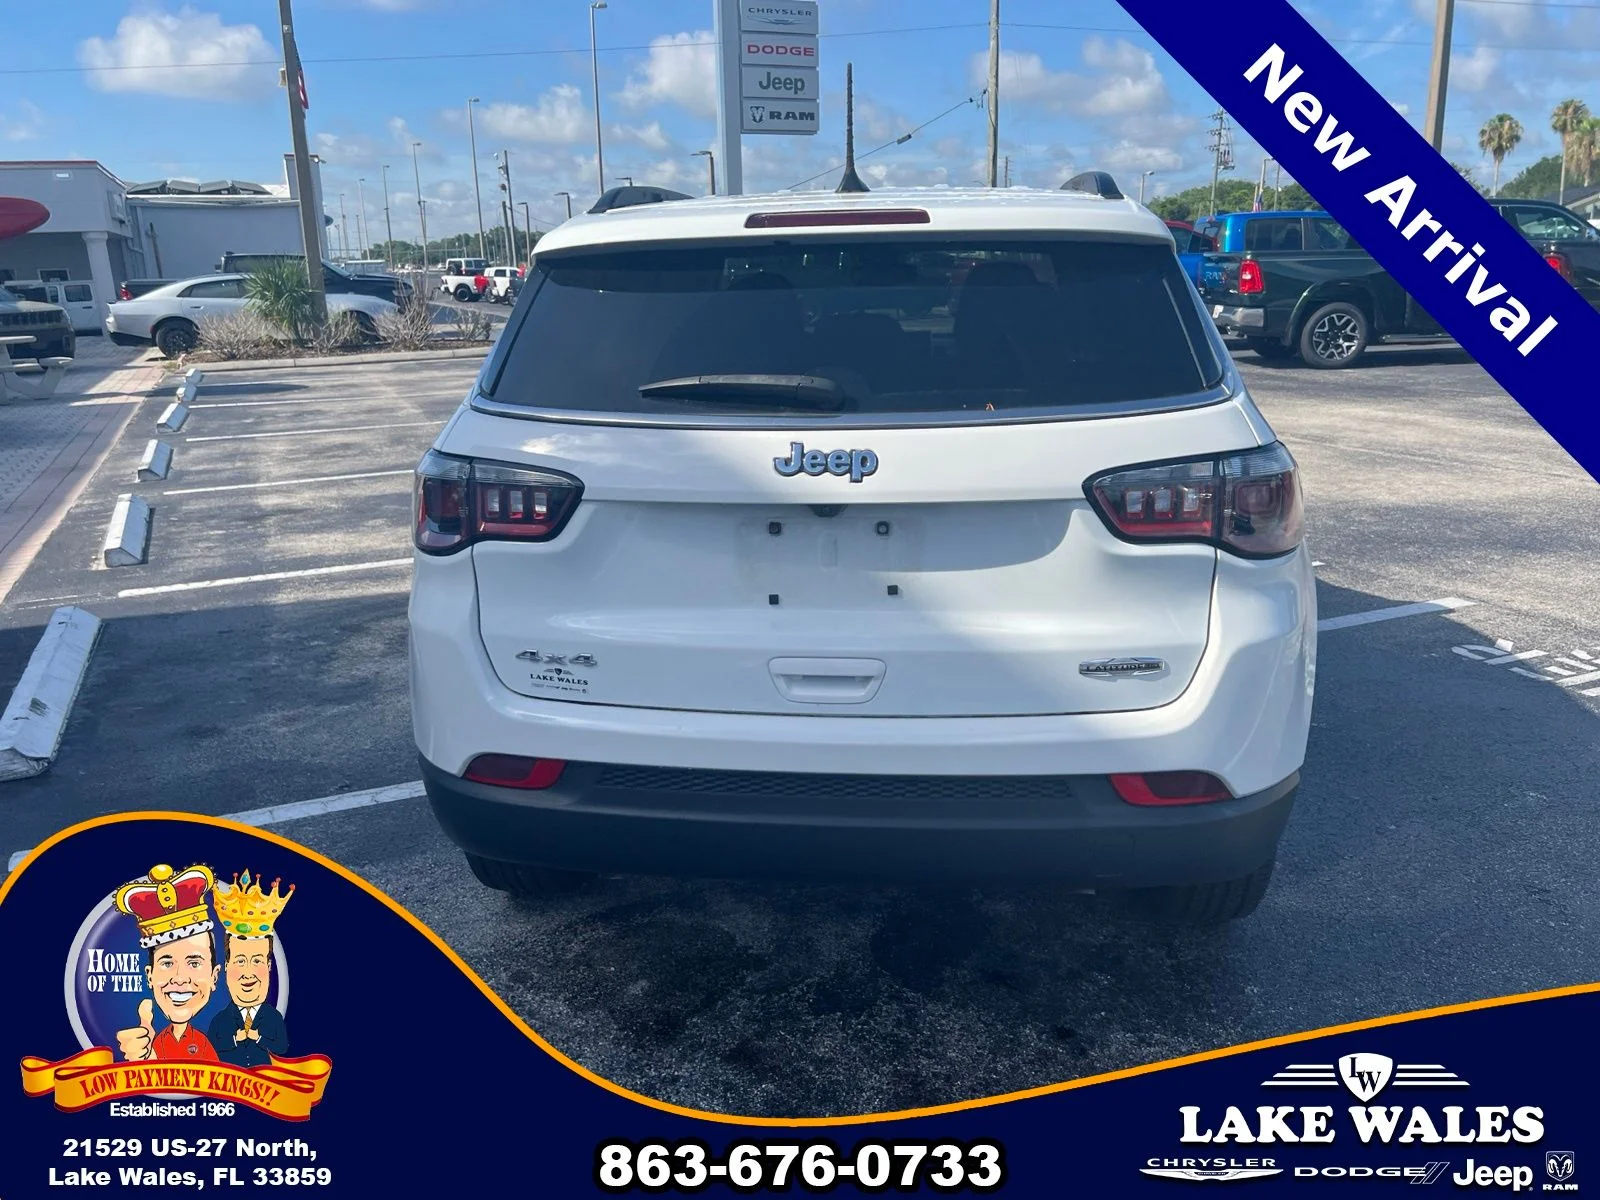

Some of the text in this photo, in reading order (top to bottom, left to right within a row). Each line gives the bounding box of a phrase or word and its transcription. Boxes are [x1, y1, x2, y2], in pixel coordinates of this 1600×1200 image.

[748, 7, 812, 16] CHRYSLER
[747, 44, 815, 56] DODGE
[759, 71, 805, 94] Jeep
[769, 111, 815, 120] RAM
[773, 441, 879, 483] Jeep
[515, 649, 597, 667] 4x4
[530, 673, 589, 686] LAKE WALES
